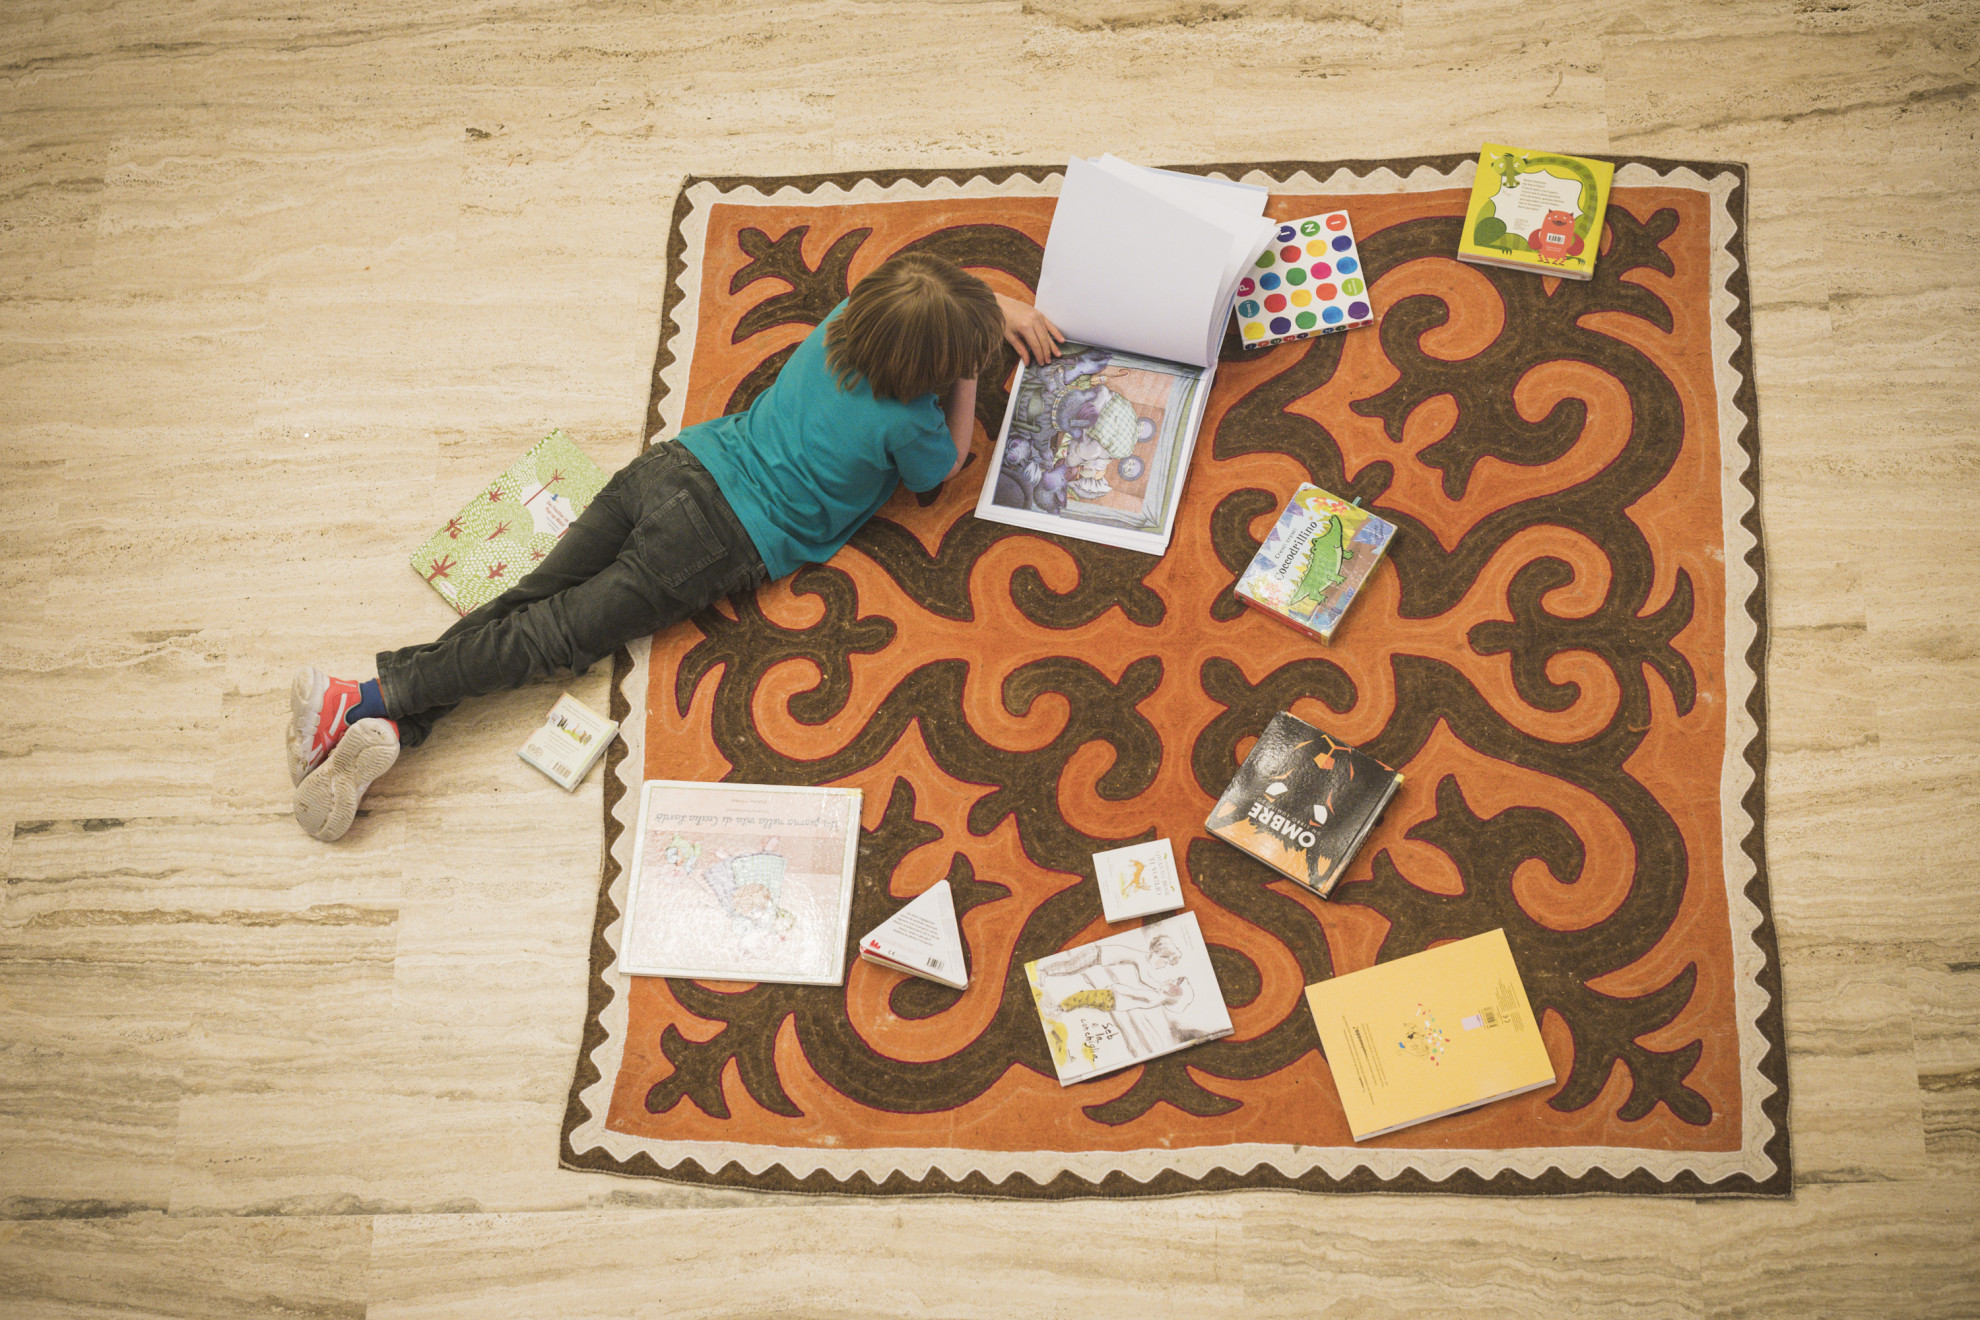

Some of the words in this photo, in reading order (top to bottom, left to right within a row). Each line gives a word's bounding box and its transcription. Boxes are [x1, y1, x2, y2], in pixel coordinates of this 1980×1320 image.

[1274, 520, 1318, 581] Coccodrillino
[1256, 796, 1290, 818] LUMINOSO
[688, 815, 719, 826] Cecilia
[721, 816, 733, 827] di
[735, 816, 755, 827] vita
[1247, 802, 1316, 848] OMBRE
[1291, 816, 1311, 830] LIBRO
[1095, 1032, 1105, 1044] la
[1102, 1022, 1119, 1040] Seb
[1080, 1018, 1100, 1062] conchiglia
